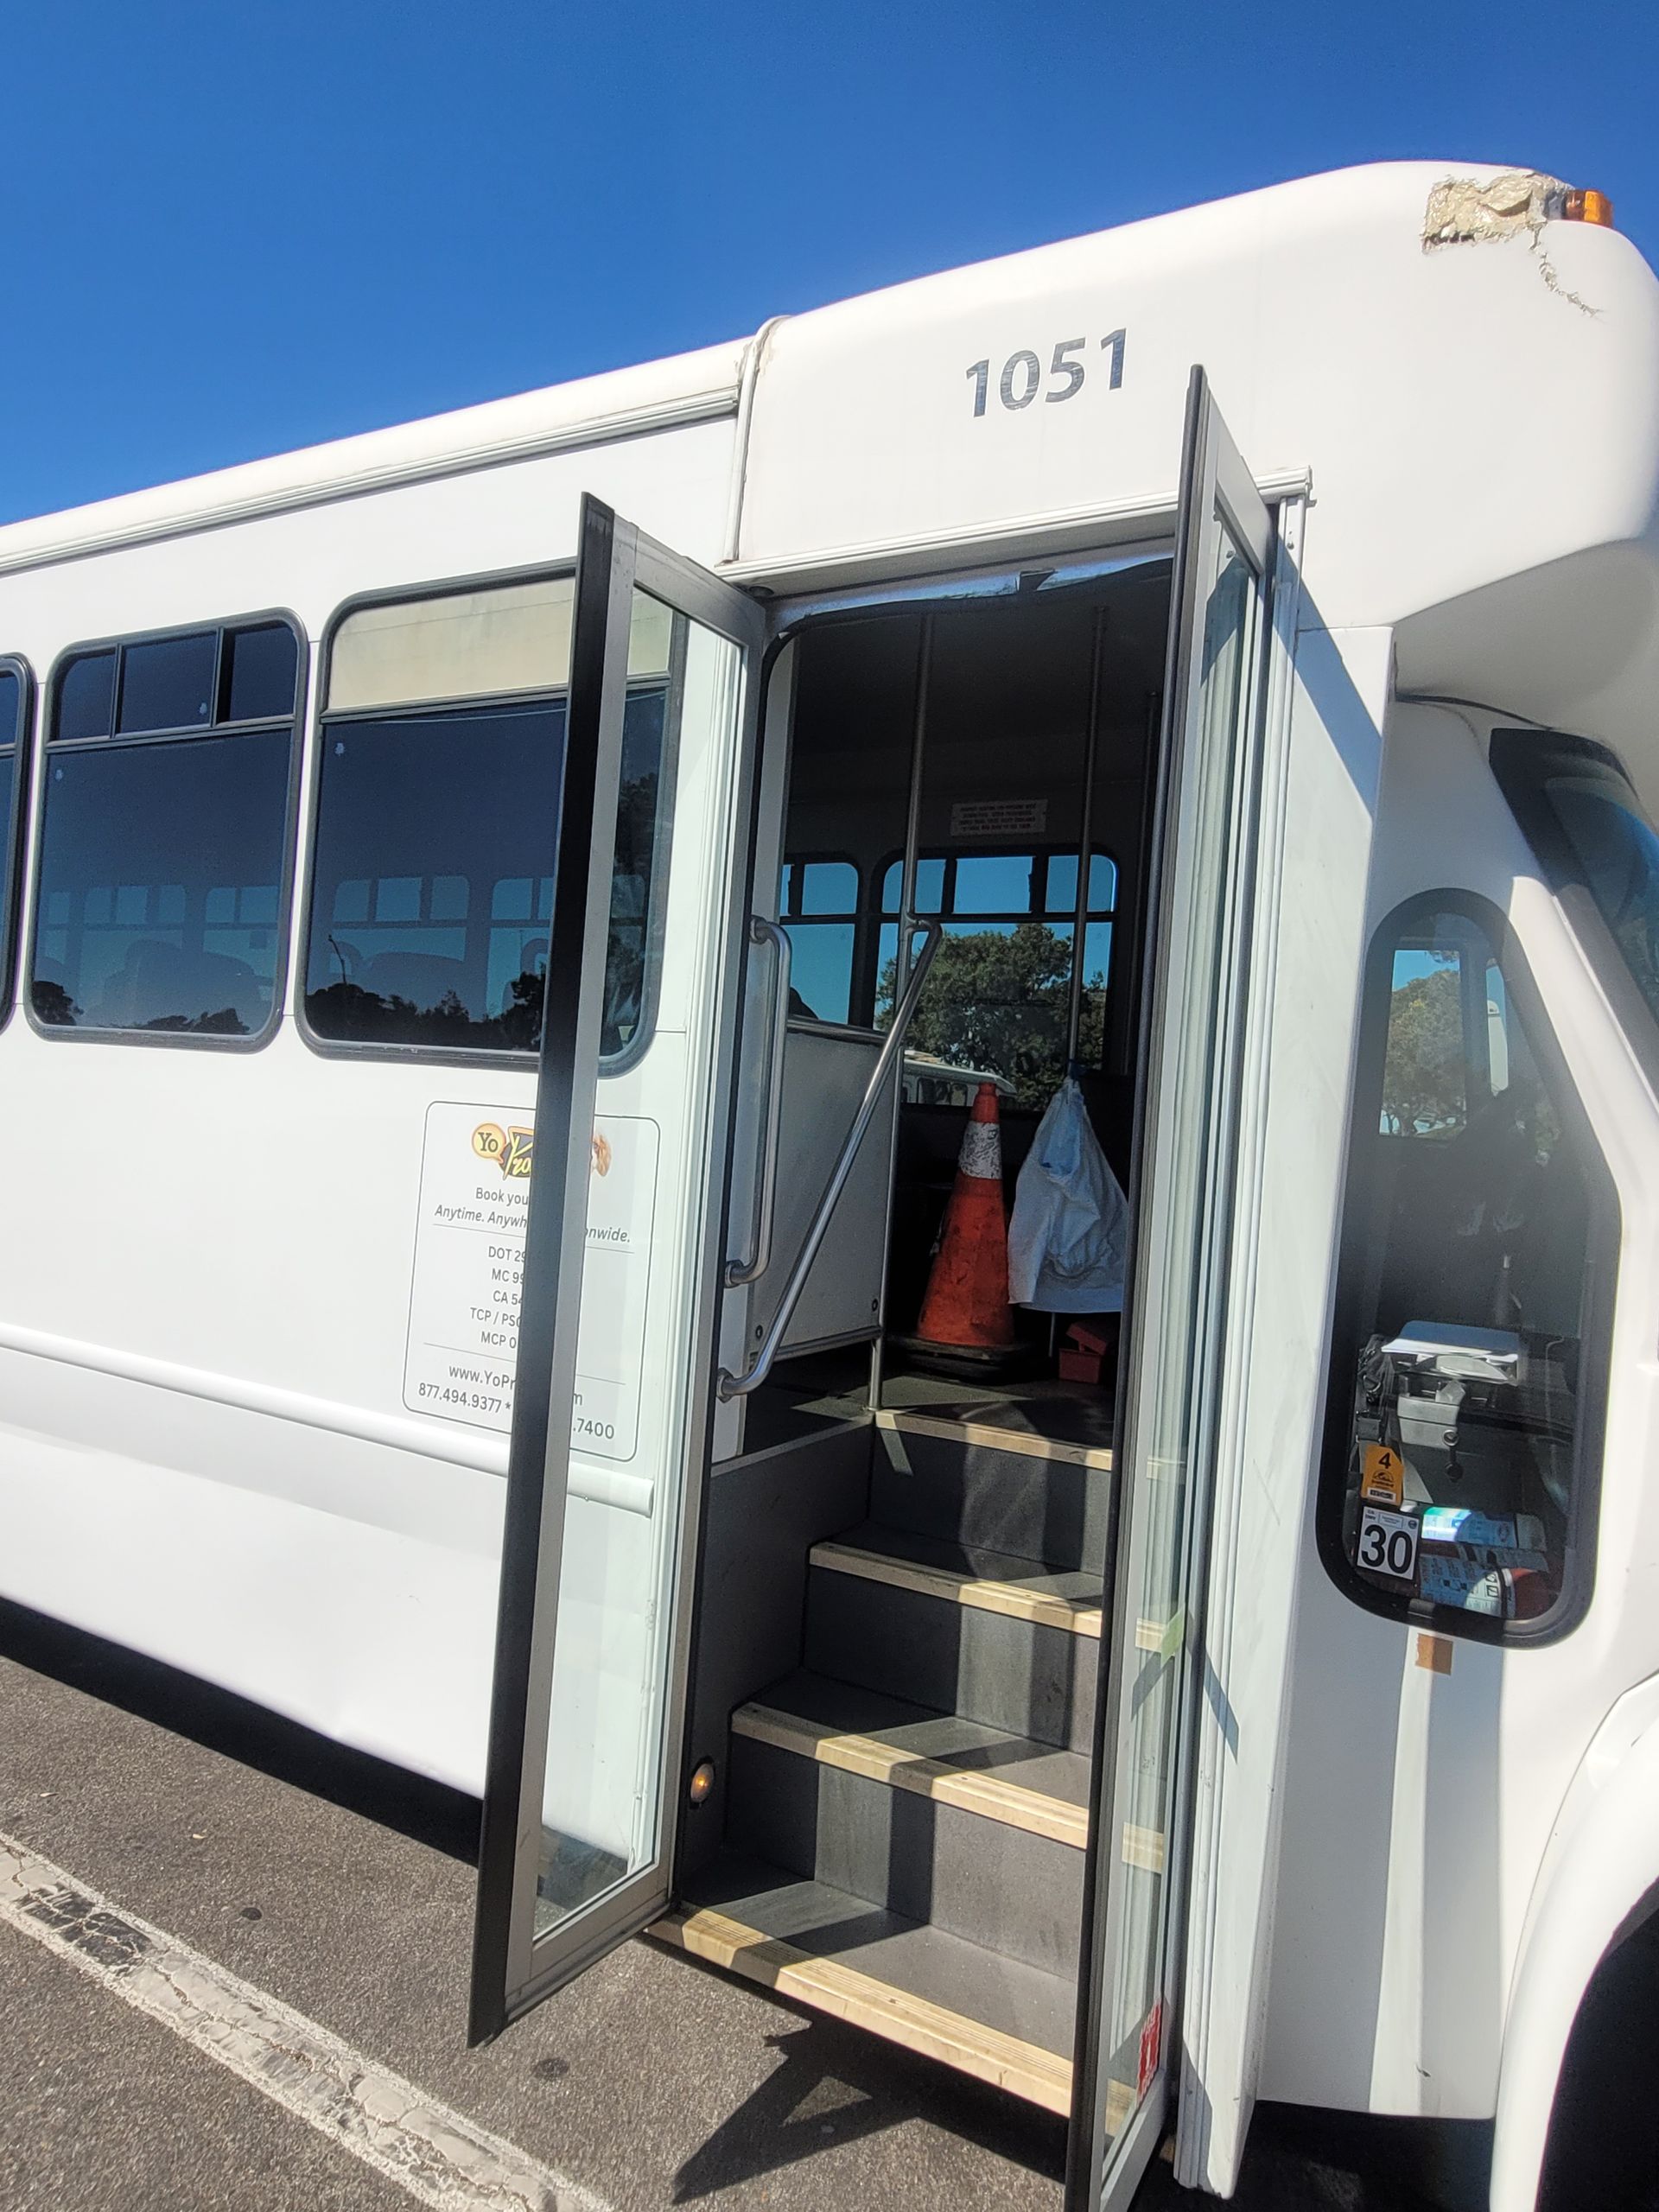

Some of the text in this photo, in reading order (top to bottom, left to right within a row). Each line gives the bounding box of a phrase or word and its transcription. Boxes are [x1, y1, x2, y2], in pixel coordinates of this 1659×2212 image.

[966, 328, 1126, 417] 1051
[478, 1132, 499, 1153] Yo
[476, 1187, 529, 1207] Book you
[435, 1205, 630, 1243] Anytime. Anywh nwide.
[488, 1246, 526, 1262] DOT 29
[492, 1268, 524, 1285] MC 99
[493, 1290, 508, 1304] CA
[470, 1306, 492, 1321] TCP
[493, 1312, 499, 1325] /
[480, 1331, 517, 1349] MCP 0
[449, 1366, 516, 1389] www.YoPr
[418, 1382, 614, 1440] 877.494.9377 .7400
[1378, 1452, 1391, 1469] 4
[1361, 1524, 1413, 1574] 30
